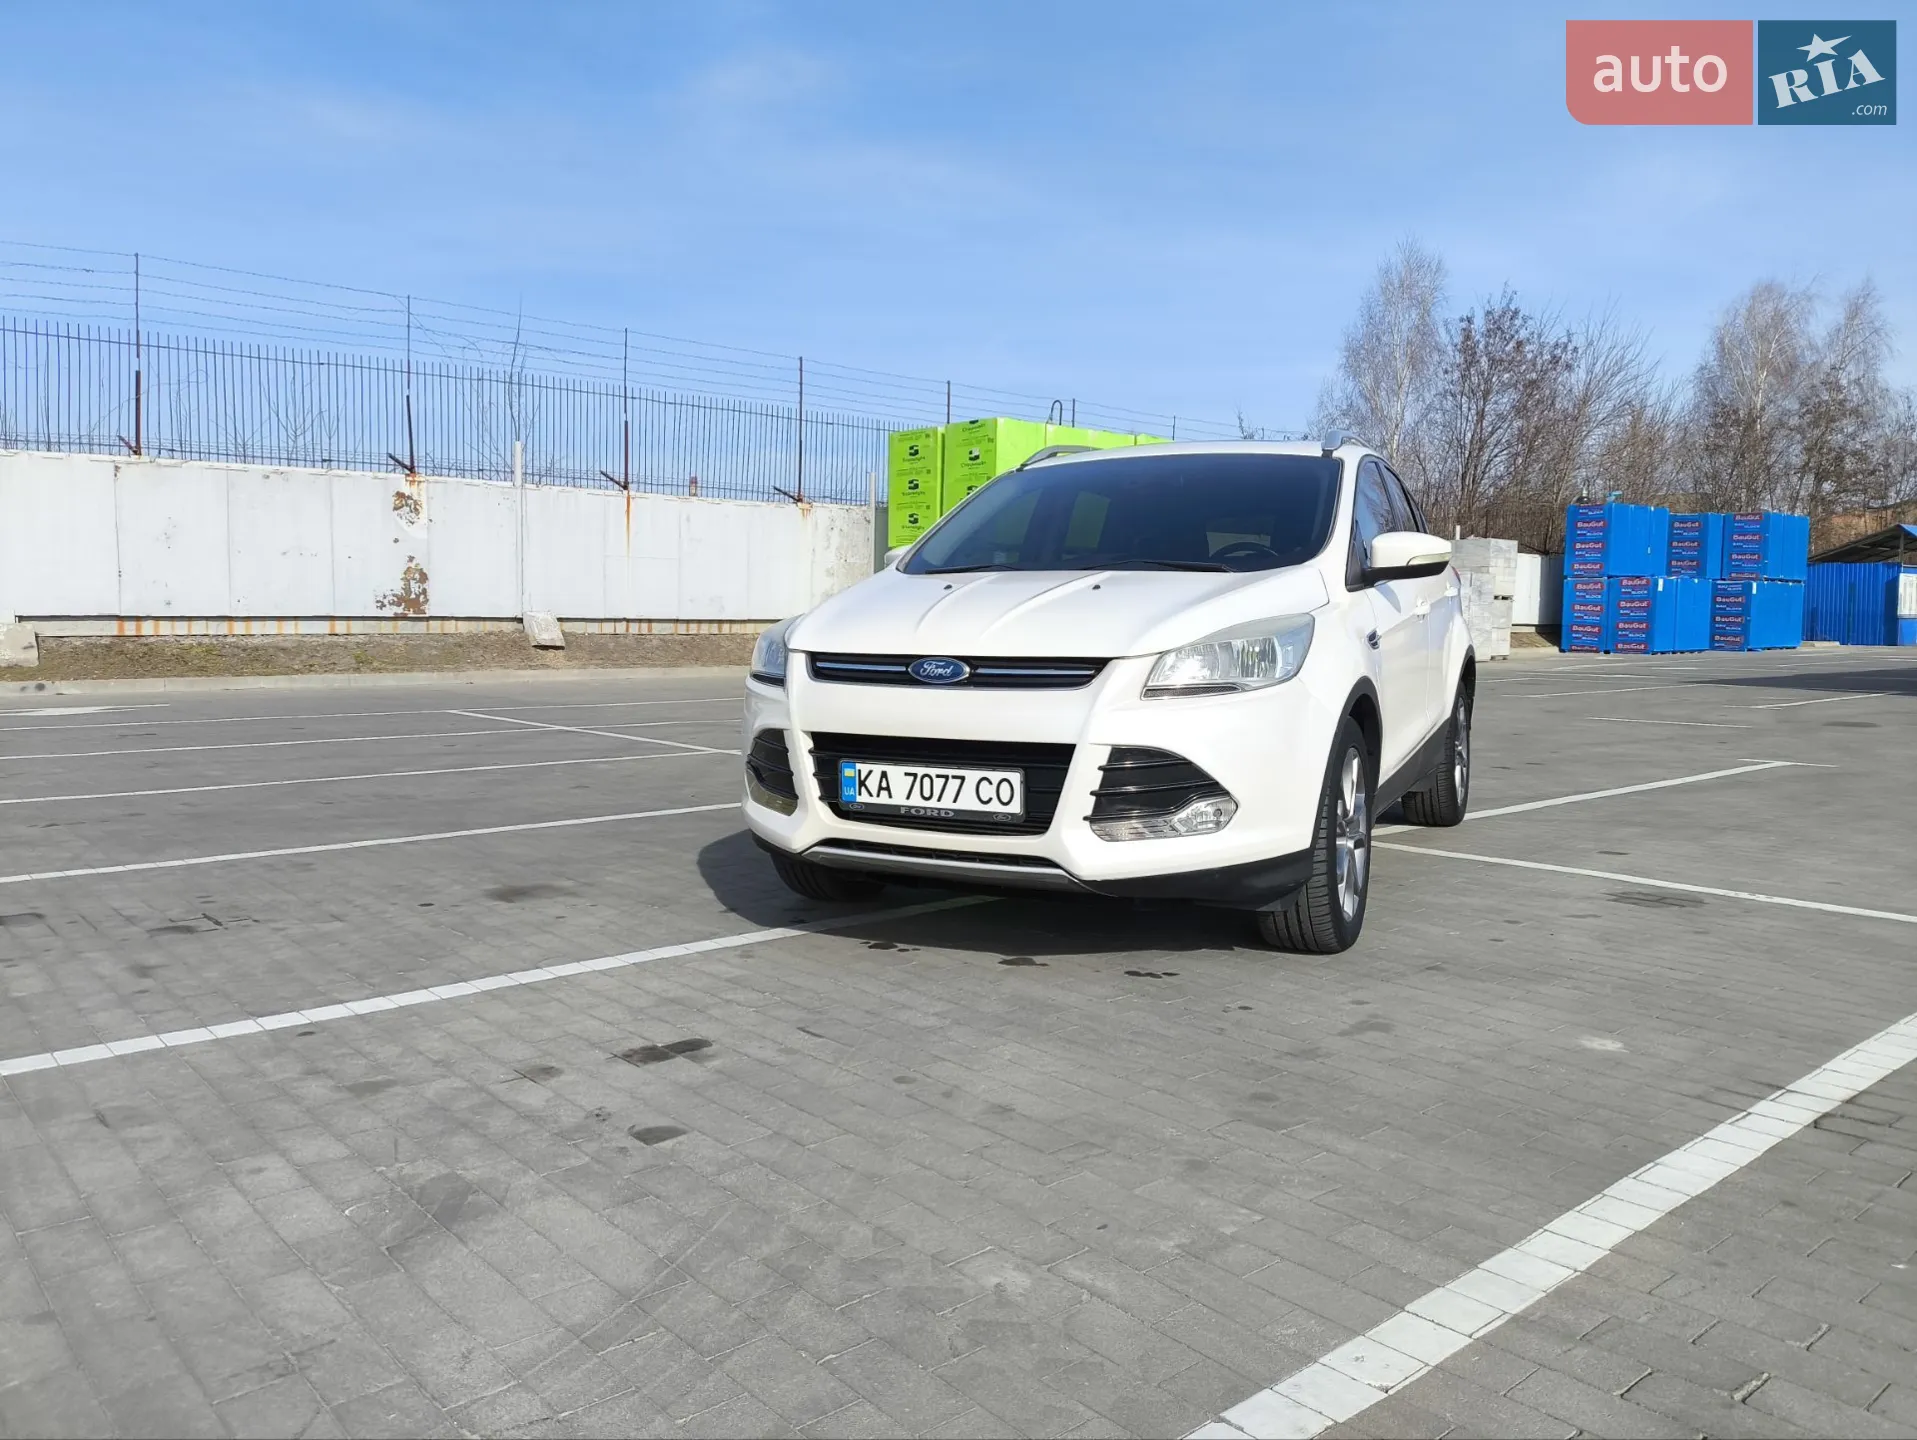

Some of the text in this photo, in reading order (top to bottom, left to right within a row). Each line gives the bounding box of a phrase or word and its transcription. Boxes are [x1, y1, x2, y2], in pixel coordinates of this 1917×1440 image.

[920, 660, 954, 676] Ford
[844, 787, 856, 796] UA
[857, 768, 1014, 806] KA 7077 CO
[900, 806, 955, 818] FORD
